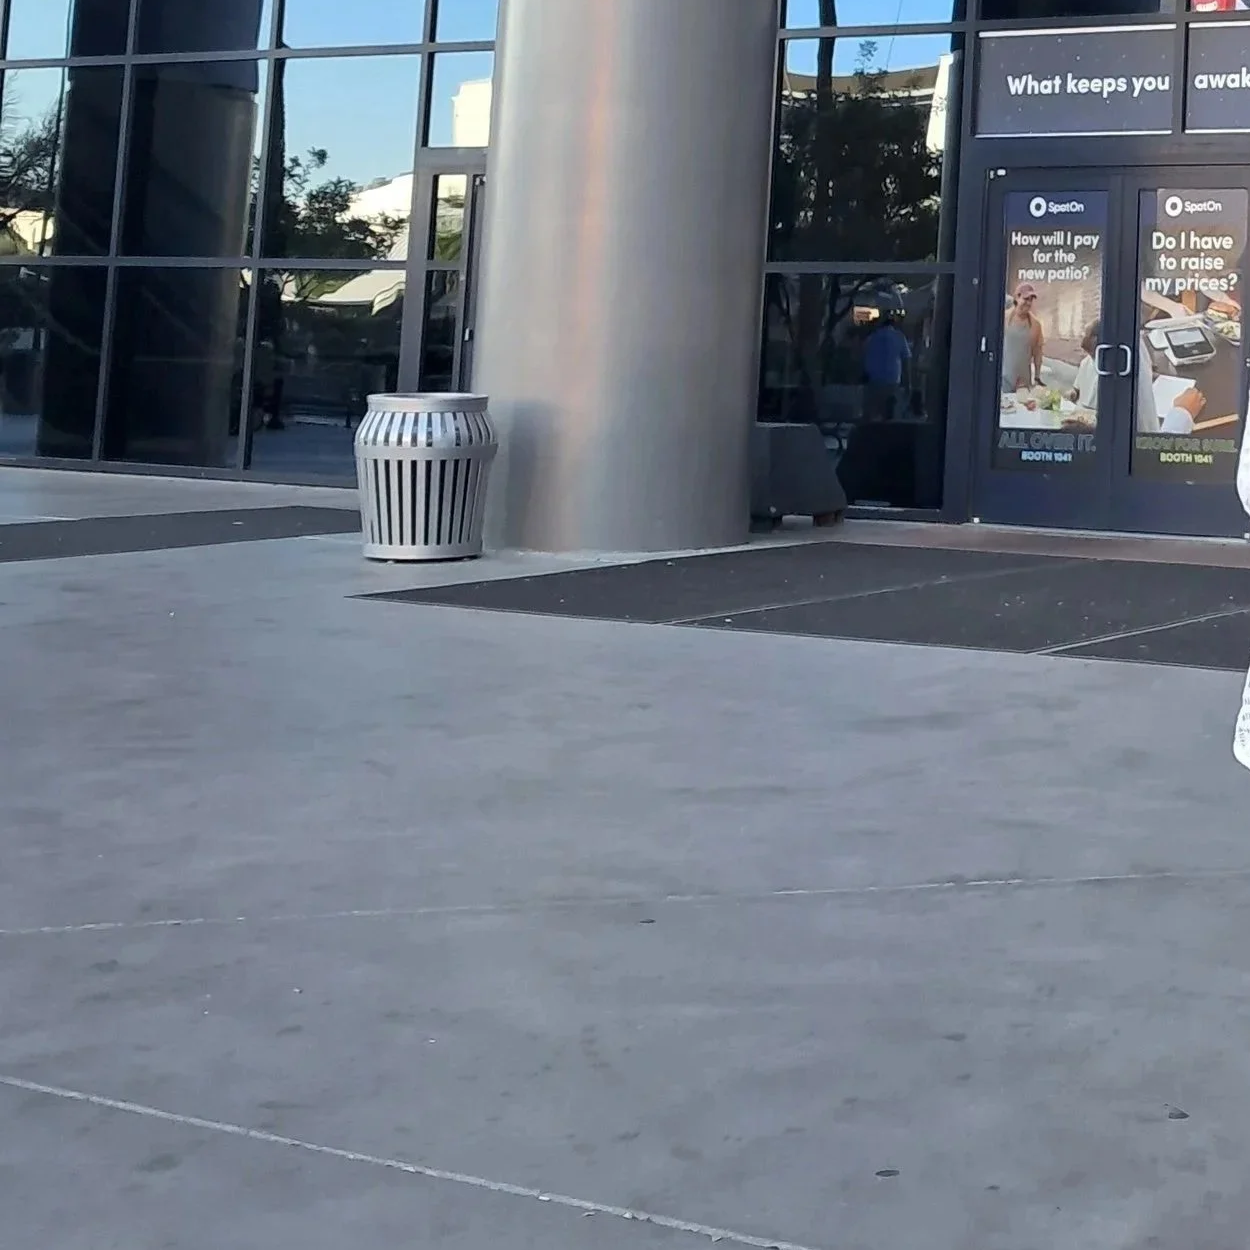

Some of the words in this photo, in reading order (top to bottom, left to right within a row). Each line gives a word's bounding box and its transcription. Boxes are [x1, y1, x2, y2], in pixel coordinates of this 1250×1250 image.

[1007, 75, 1062, 96] What
[1066, 73, 1127, 99] keeps
[1131, 75, 1170, 98] you
[1048, 201, 1085, 214] SpotOn
[1184, 201, 1222, 214] SpotOn
[1011, 231, 1040, 246] How
[1042, 231, 1065, 246] will
[1067, 232, 1072, 245] I
[1074, 234, 1100, 250] pay
[1152, 232, 1177, 250] Do
[1180, 232, 1185, 249] I
[1190, 231, 1234, 250] have
[1032, 249, 1052, 263] for
[1054, 249, 1076, 263] the
[1159, 253, 1178, 271] to
[1180, 253, 1225, 271] raise
[1018, 268, 1046, 280] new
[1047, 266, 1090, 283] patio?
[1145, 278, 1174, 295] my
[1175, 273, 1238, 295] prices?
[1021, 450, 1052, 461] BOOTH
[1160, 452, 1192, 462] BOOTH
[1194, 454, 1213, 463] 1041
